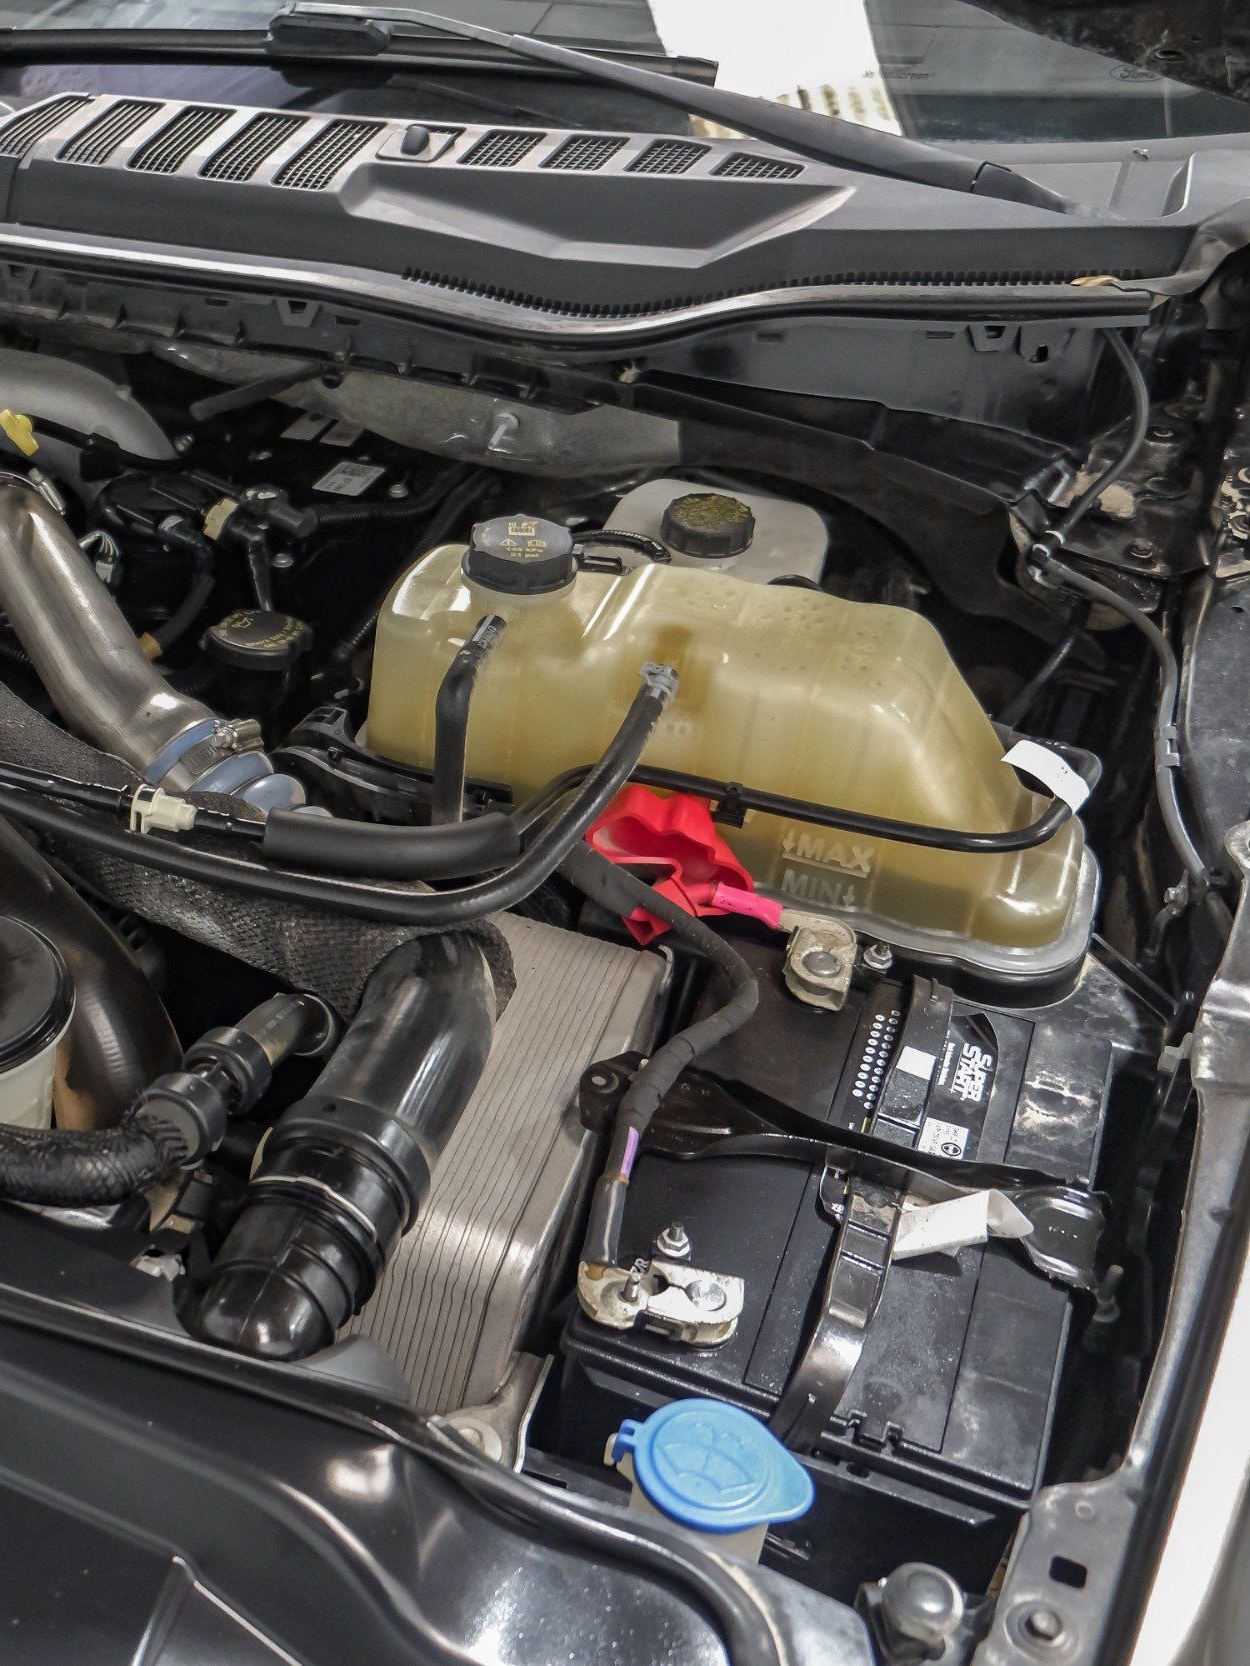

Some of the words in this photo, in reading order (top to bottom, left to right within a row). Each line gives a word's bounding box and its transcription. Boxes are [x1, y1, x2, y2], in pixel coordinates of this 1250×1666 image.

[796, 832, 875, 874] MAX
[781, 868, 843, 905] MIN
[950, 1042, 983, 1101] START
